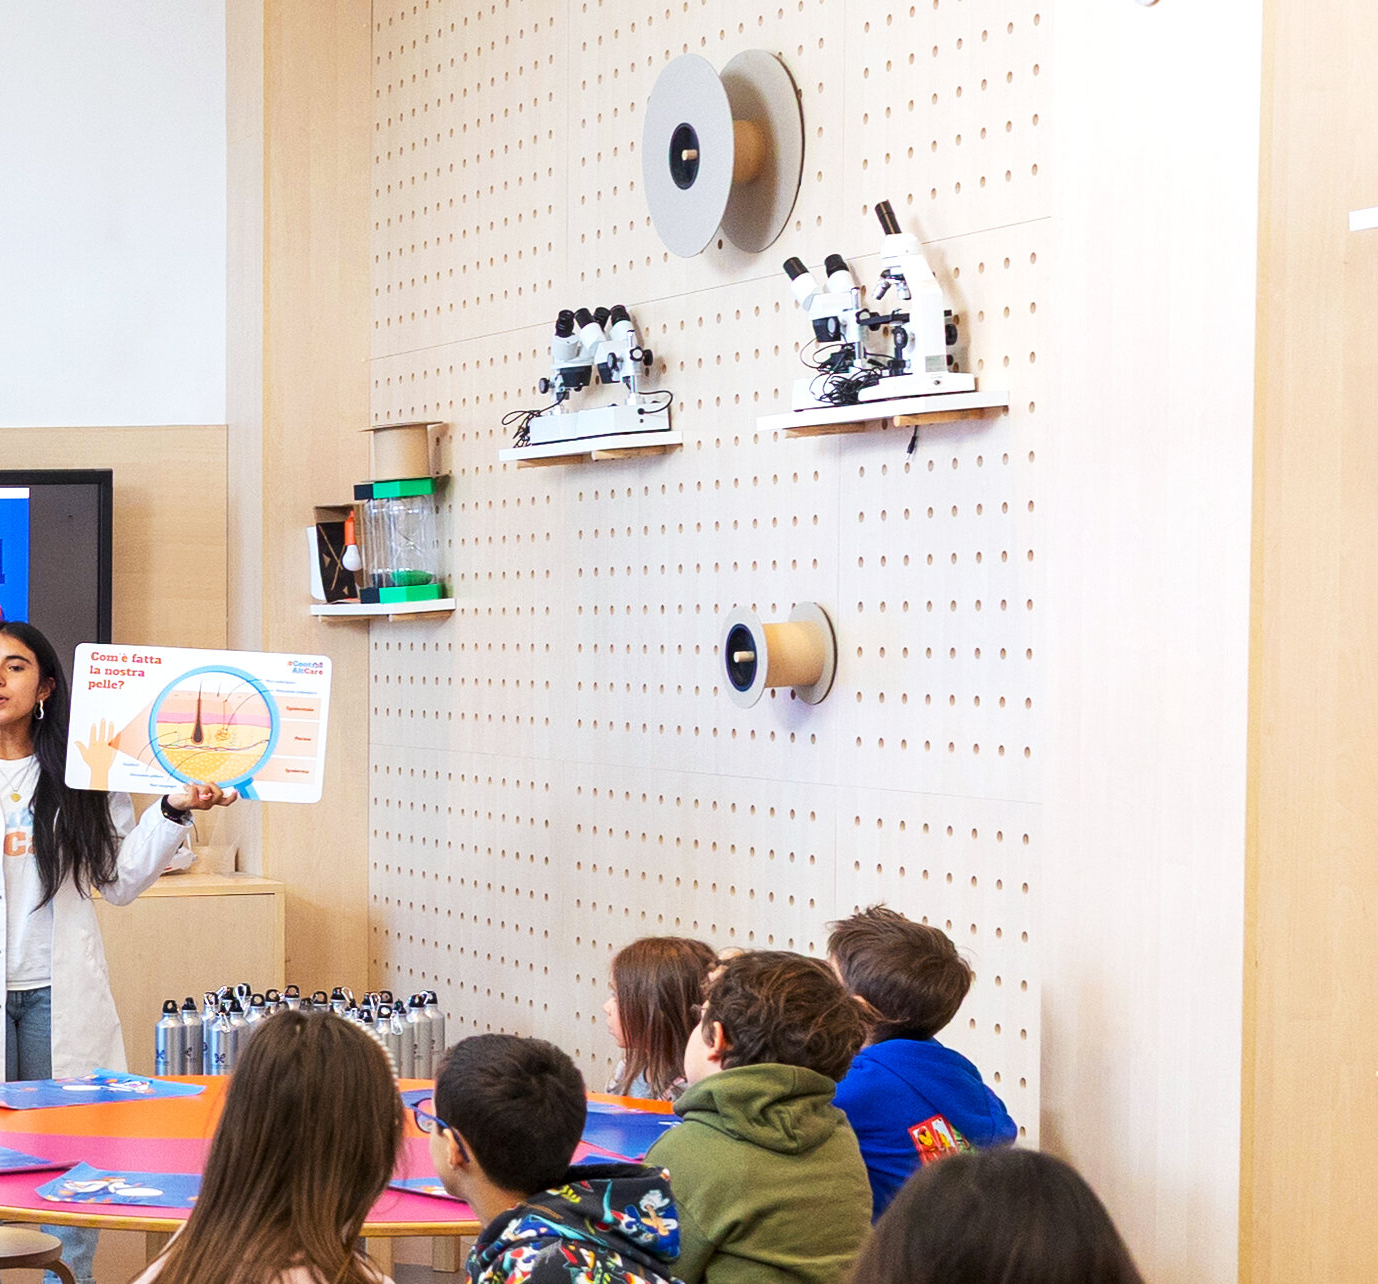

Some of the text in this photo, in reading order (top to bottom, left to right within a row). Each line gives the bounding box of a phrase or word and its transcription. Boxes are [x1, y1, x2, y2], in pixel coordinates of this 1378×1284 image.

[132, 654, 162, 664] fatta
[89, 665, 145, 677] la nostra
[88, 680, 125, 690] pelle?
